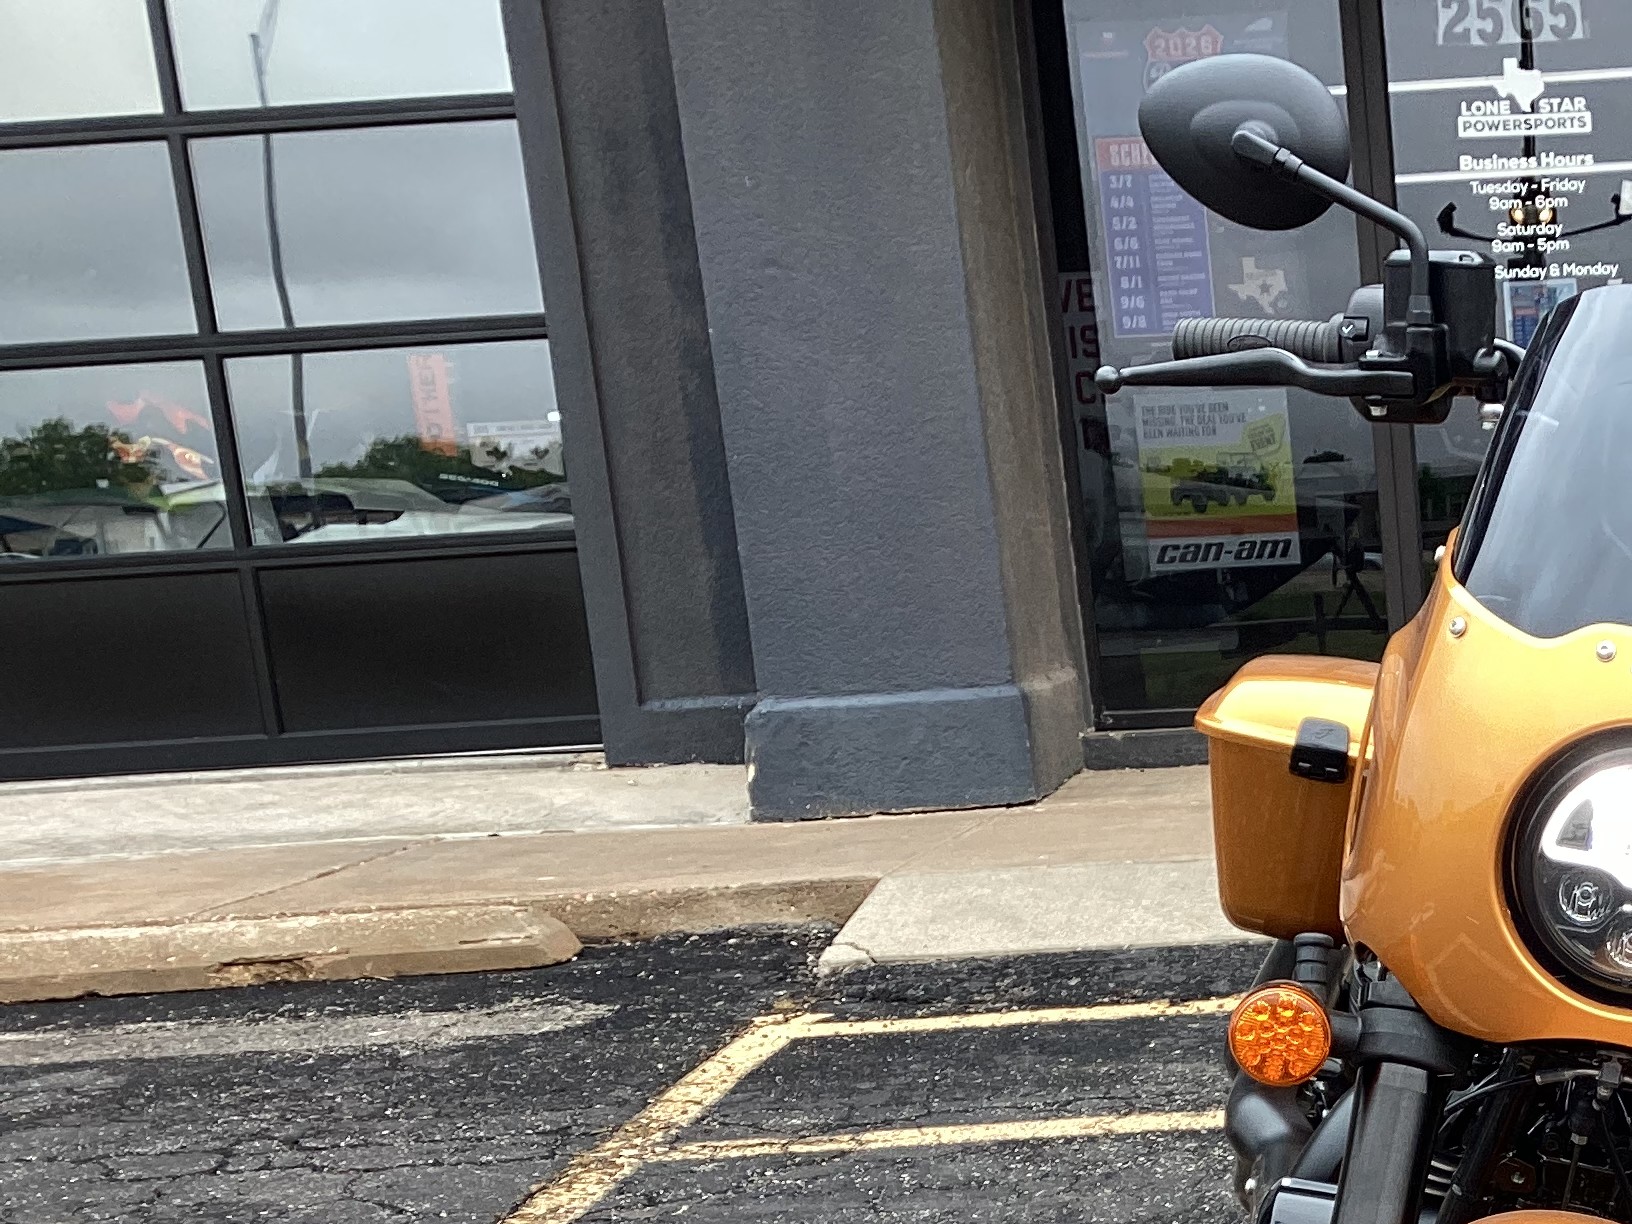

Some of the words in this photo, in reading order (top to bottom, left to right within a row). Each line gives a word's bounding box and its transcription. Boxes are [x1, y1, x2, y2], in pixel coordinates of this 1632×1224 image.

[1442, 0, 1577, 44] 2565
[1460, 100, 1511, 116] LONE
[1539, 96, 1587, 114] STAR
[1463, 115, 1587, 133] POWERSPORTS
[1459, 153, 1538, 171] Business
[1540, 152, 1594, 168] Hours
[1470, 179, 1529, 196] Tuesday
[1541, 177, 1586, 193] Friday
[1489, 197, 1523, 210] 9am
[1535, 196, 1568, 210] 6pm
[1497, 221, 1563, 237] Saturday
[1491, 239, 1525, 253] 9am
[1537, 238, 1570, 254] 5pm
[1495, 264, 1547, 280] Sunday
[1550, 263, 1560, 276] &
[1563, 261, 1619, 277] Monday
[1156, 536, 1292, 565] can-am
